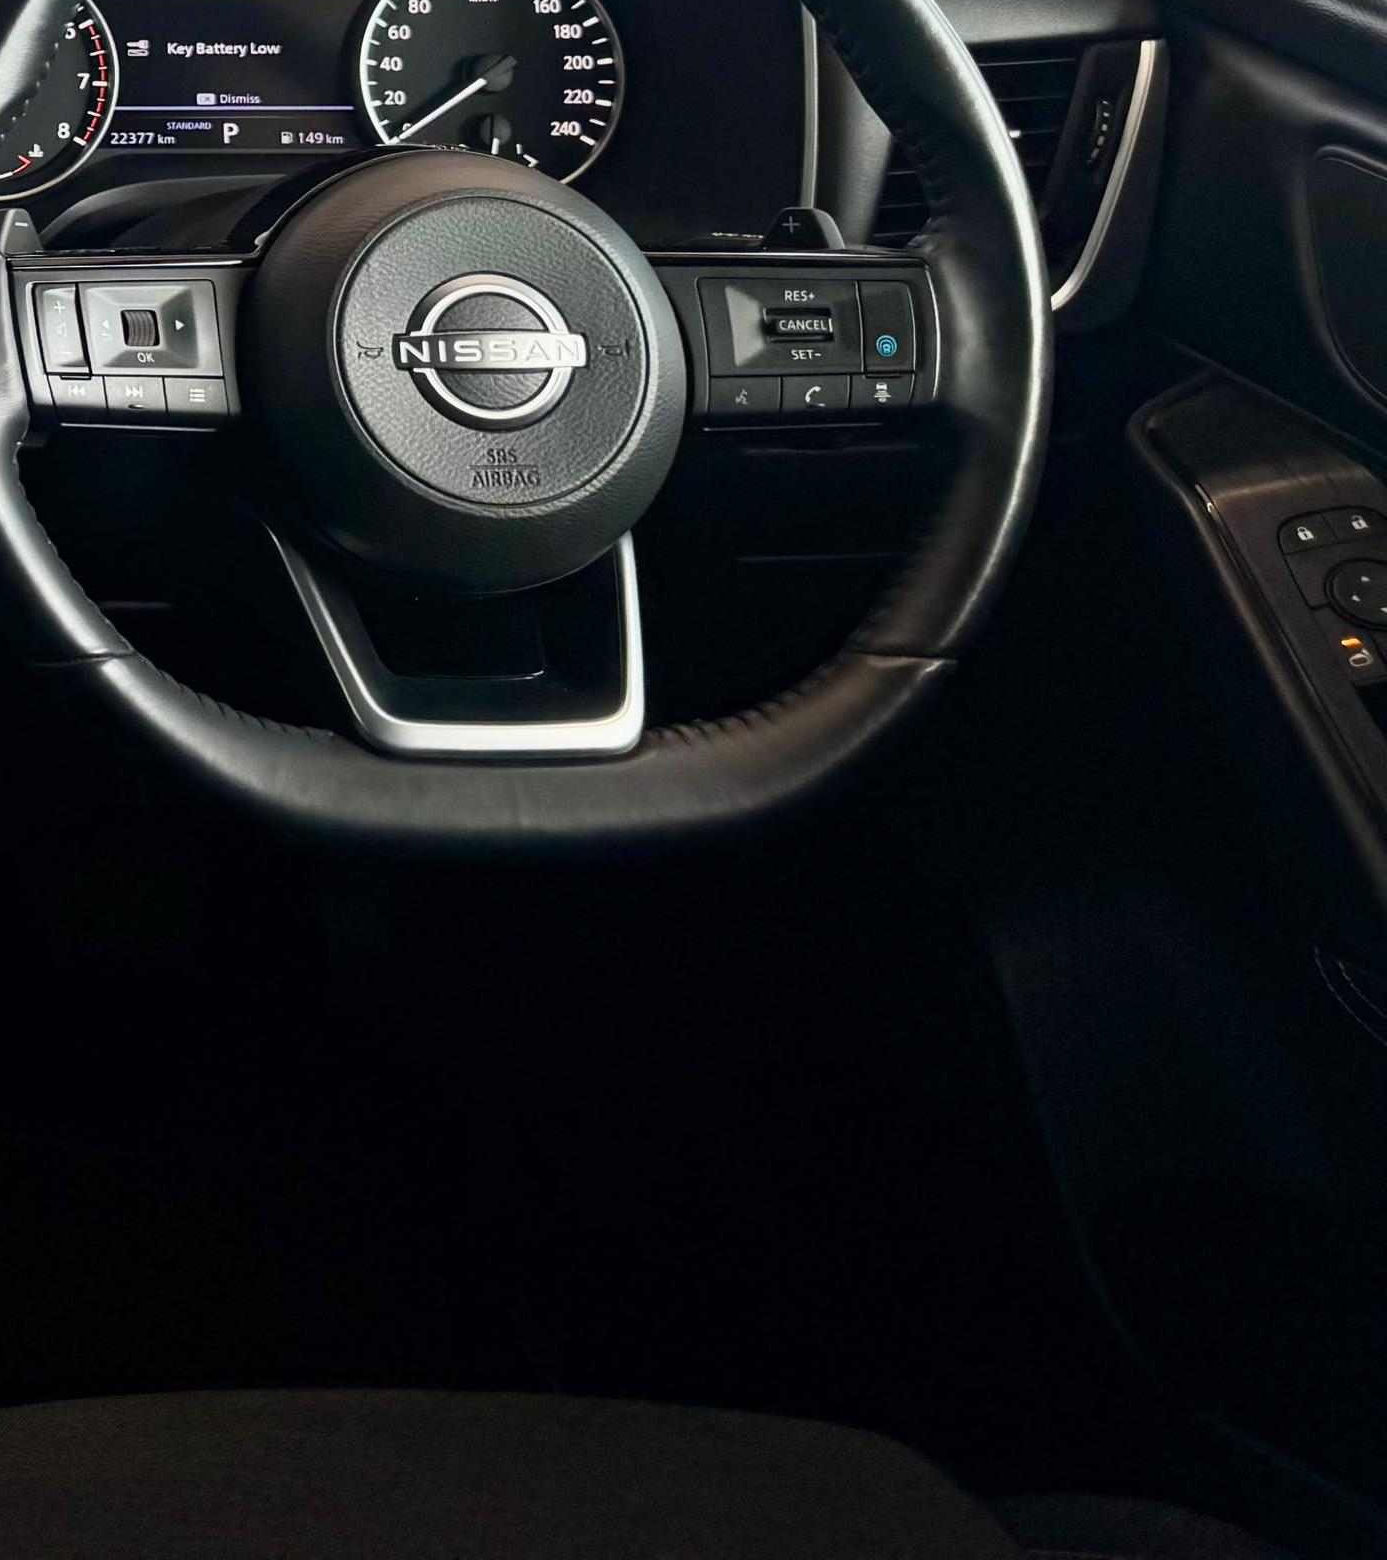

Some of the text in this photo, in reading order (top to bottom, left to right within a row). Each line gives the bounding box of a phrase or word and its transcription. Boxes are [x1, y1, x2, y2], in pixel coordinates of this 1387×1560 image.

[533, 0, 562, 15] 160
[387, 25, 411, 41] 60
[553, 24, 582, 40] 180
[166, 42, 282, 58] Key Battery Low
[379, 56, 403, 72] 40
[563, 55, 594, 71] 200
[77, 72, 91, 90] 7
[219, 94, 262, 105] Dismiss
[384, 90, 406, 106] 20
[563, 89, 594, 105] 220
[57, 122, 71, 140] 8
[166, 121, 212, 131] STANDARD
[222, 122, 240, 144] P
[550, 121, 581, 137] 240
[109, 131, 176, 145] 22377 km
[297, 131, 344, 145] 149 km
[784, 290, 816, 303] RES+
[778, 319, 827, 331] CANCEL
[136, 352, 155, 364] OK
[399, 339, 581, 364] NISSAN
[790, 349, 822, 361] SET-
[486, 448, 518, 464] SRS
[471, 470, 542, 489] AIRBAG
